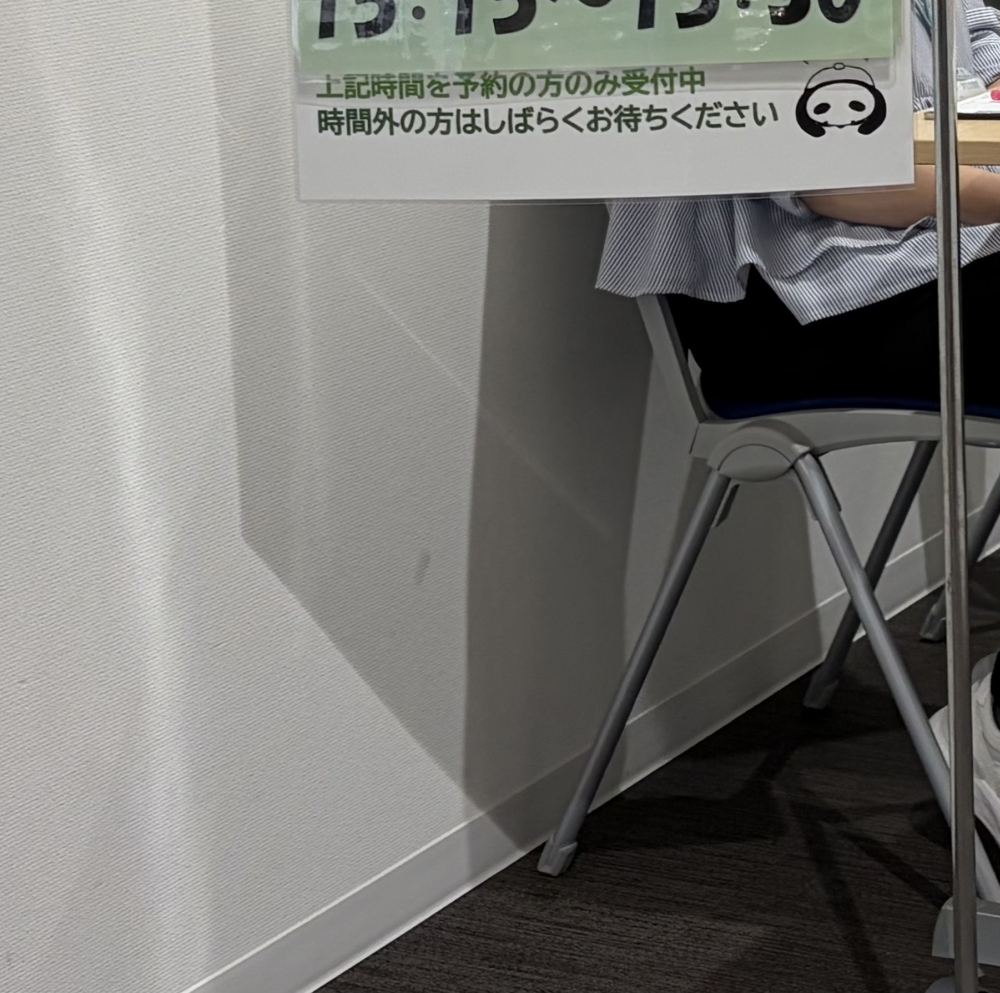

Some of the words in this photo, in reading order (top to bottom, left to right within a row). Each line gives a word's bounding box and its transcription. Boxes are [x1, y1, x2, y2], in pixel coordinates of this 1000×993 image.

[316, 67, 706, 100] 上記時間を予約の方のみ受付中
[317, 102, 778, 136] 時間外の方はしばらくお待ちください
